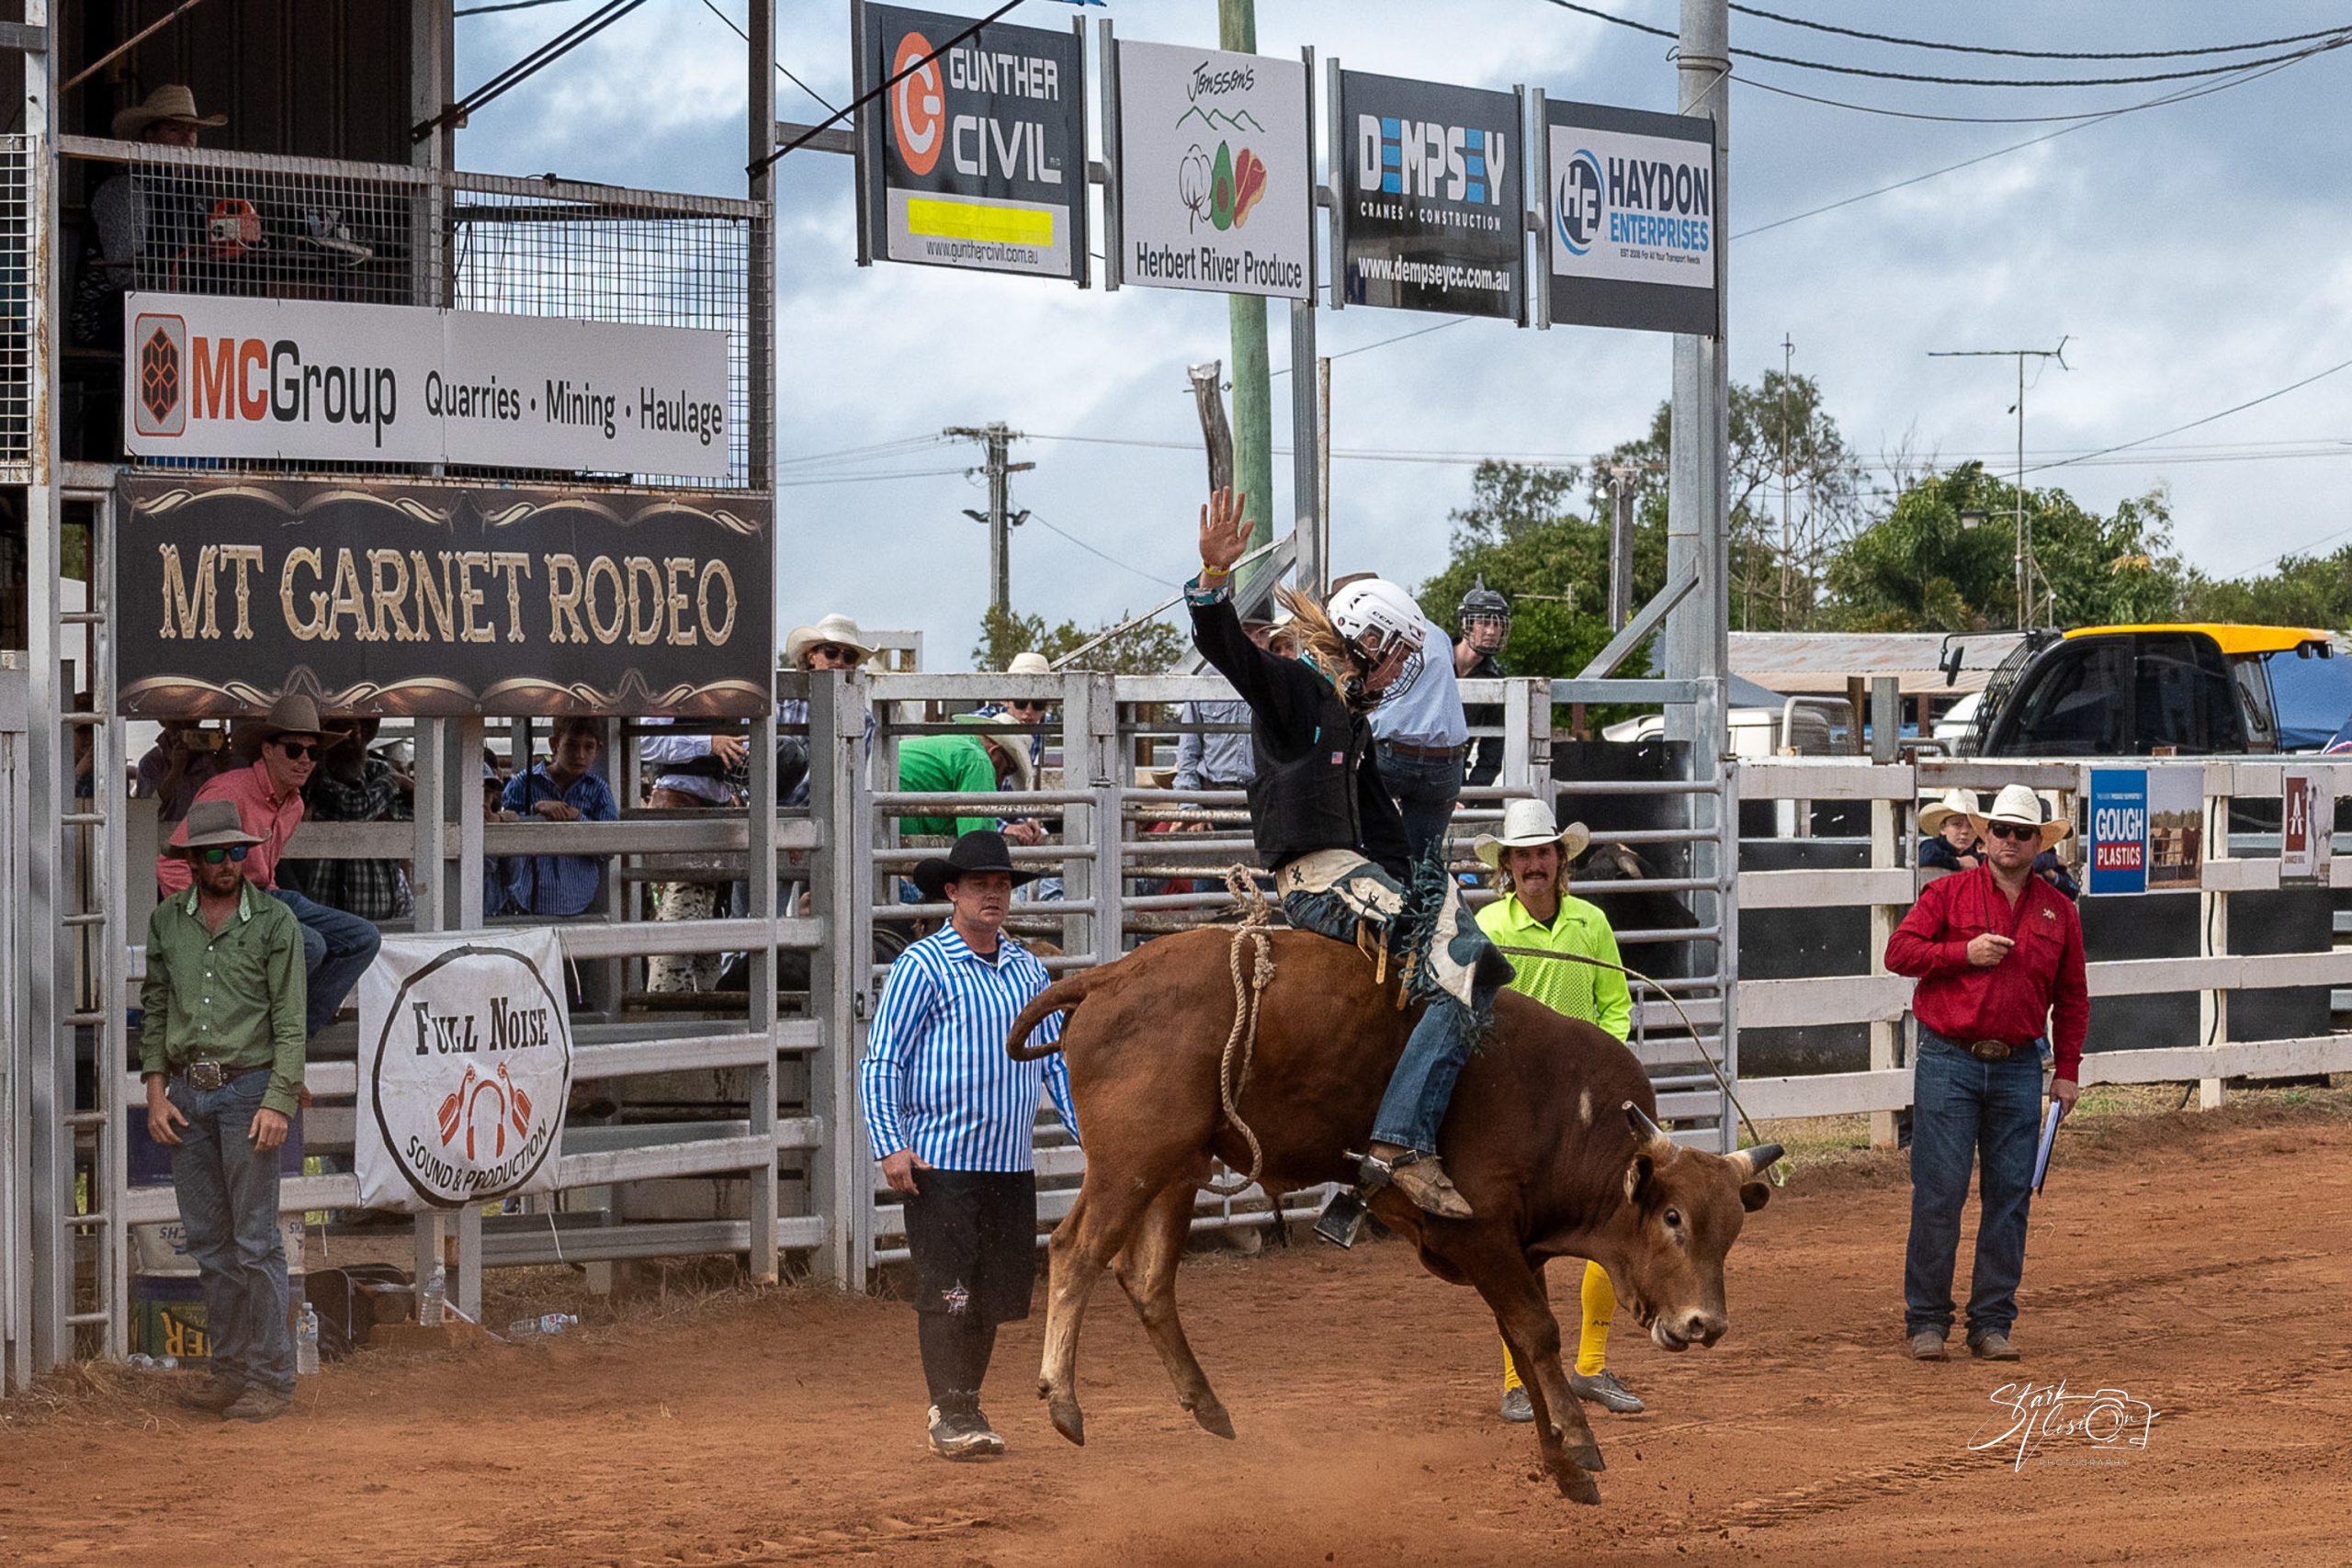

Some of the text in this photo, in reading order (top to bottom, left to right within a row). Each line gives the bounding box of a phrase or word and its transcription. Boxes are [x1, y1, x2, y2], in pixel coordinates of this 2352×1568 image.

[949, 47, 1058, 101] GUNTHER
[952, 114, 1062, 184] CIVIL
[1358, 113, 1506, 206] DEMPSEY
[1608, 156, 1710, 217] HAYDON
[1360, 201, 1501, 231] CRANES CONSTRUCTION
[1610, 211, 1709, 253] ENTERPRISES
[926, 240, 1039, 265] www.gunthercivil.com.au
[1136, 241, 1302, 288] Herbert River Produce
[1358, 254, 1511, 292] www.dempseycc.com.au
[192, 335, 398, 448] MCGroup
[425, 368, 723, 447] Quarries Mining Haulage
[159, 542, 739, 647] MT GARNET RODEO
[2096, 807, 2143, 841] GOUGH
[2098, 847, 2141, 866] PLASTICS
[413, 997, 549, 1055] FULL NOISE
